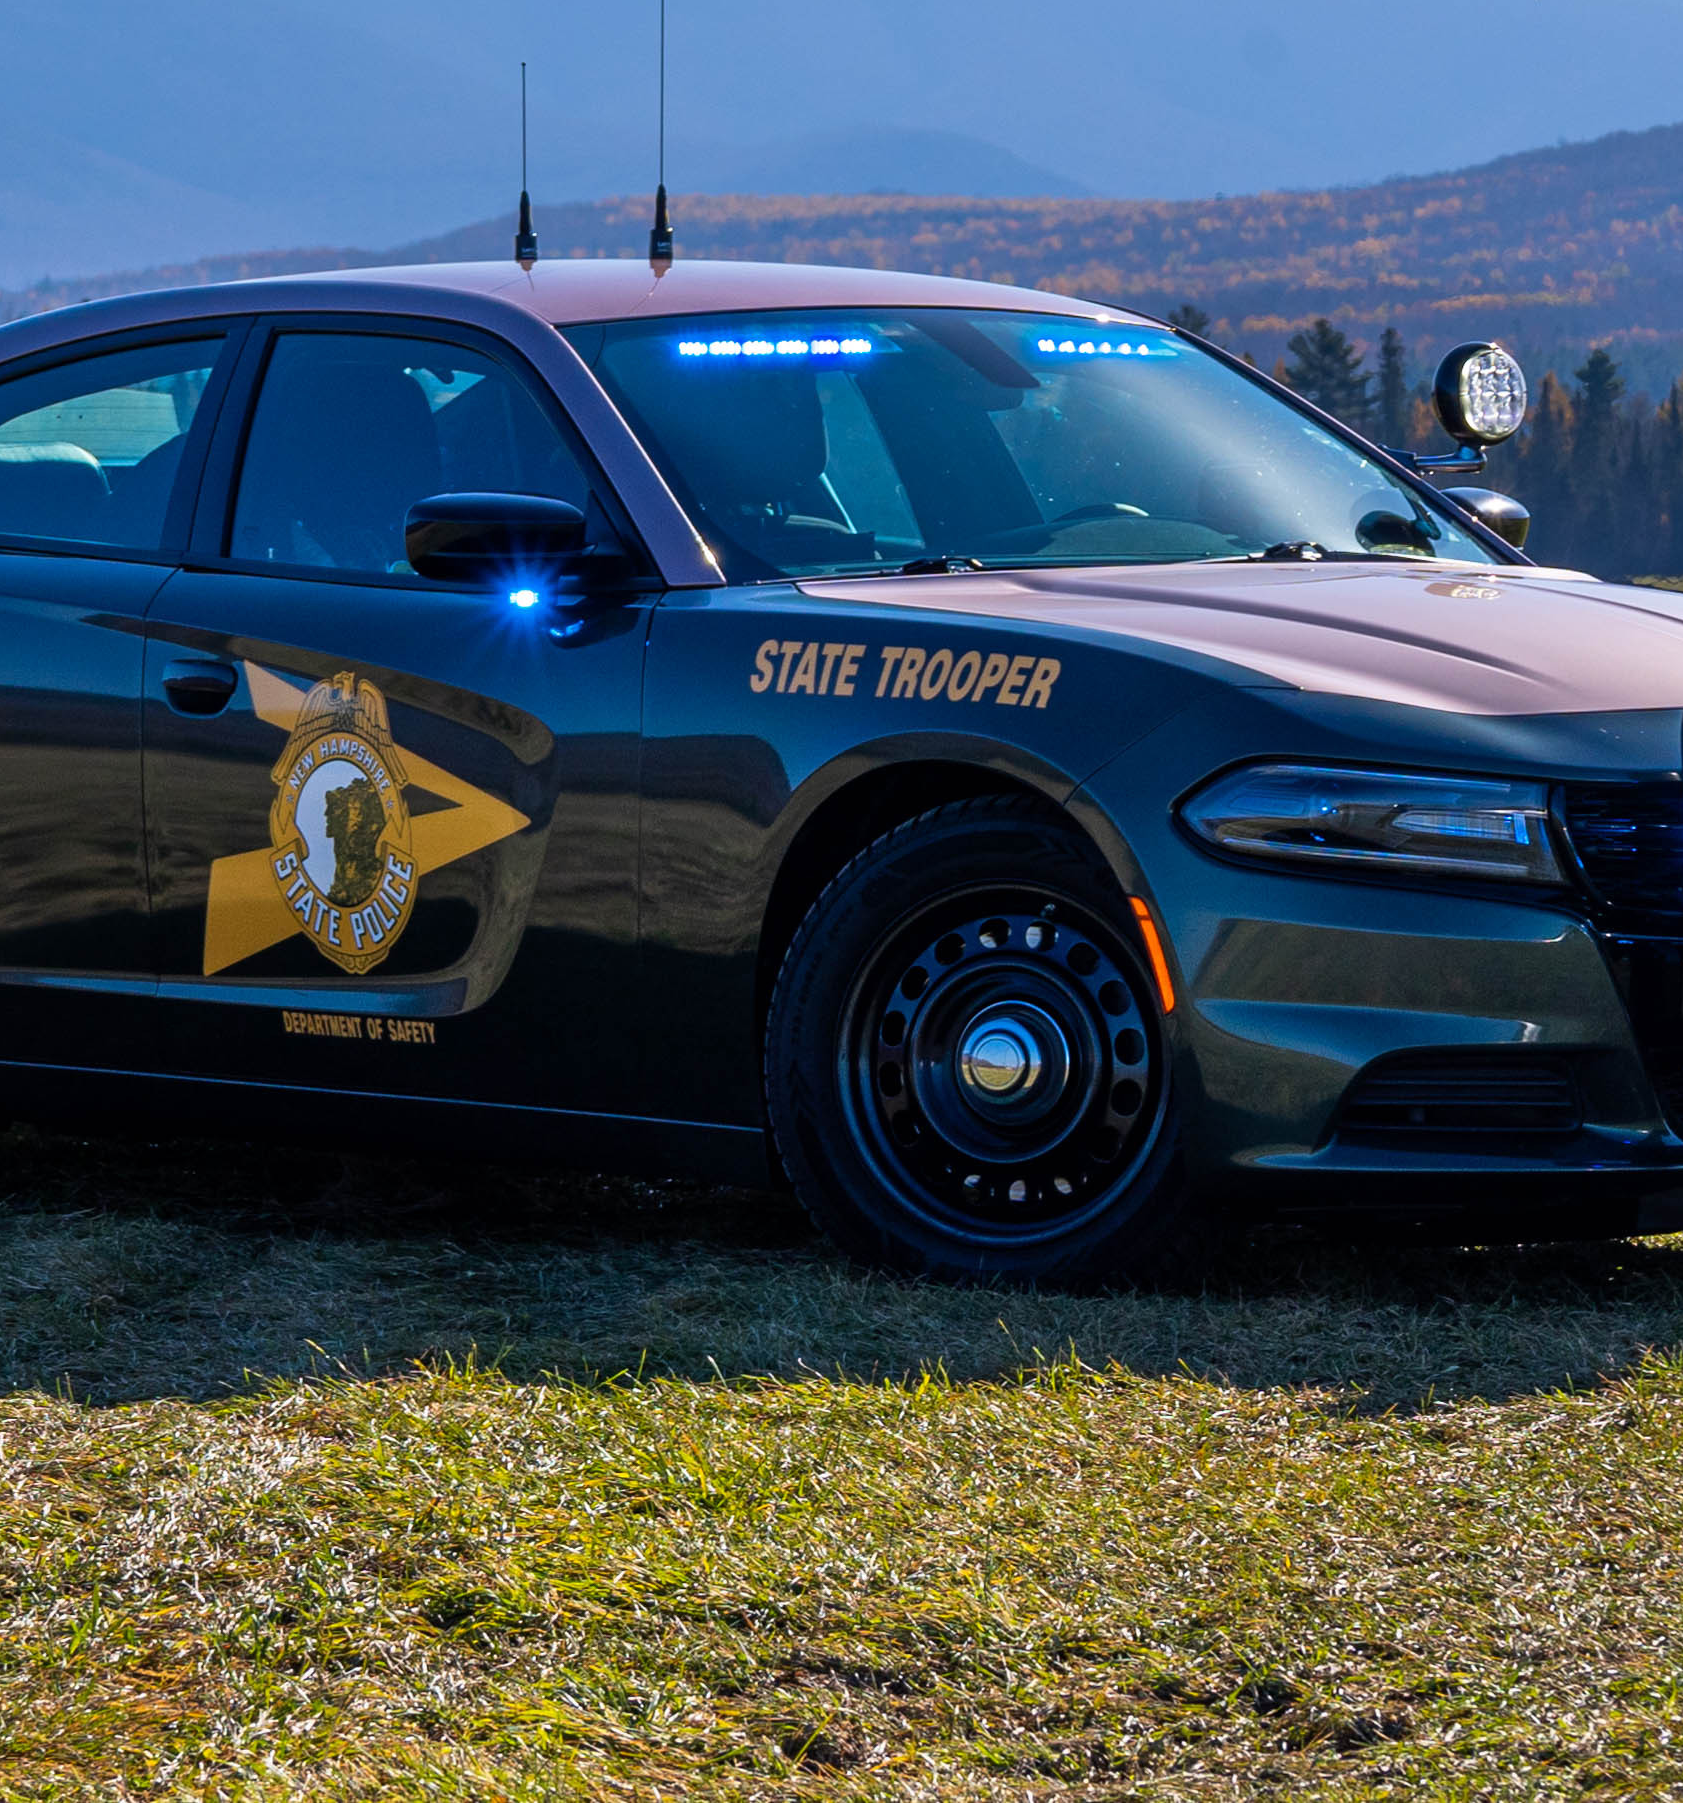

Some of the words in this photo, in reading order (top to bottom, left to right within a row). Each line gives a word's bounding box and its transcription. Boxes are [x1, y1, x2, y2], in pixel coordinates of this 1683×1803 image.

[750, 639, 867, 697] STATE
[874, 646, 1062, 709] TROOPER
[288, 750, 315, 790] NEW
[320, 738, 392, 793] HAMPSHIRE
[274, 852, 342, 946] STATE
[349, 853, 414, 949] POLICE
[282, 1010, 362, 1038] DEPARTMENT
[366, 1017, 383, 1040] OF
[387, 1018, 436, 1044] SAFETY
